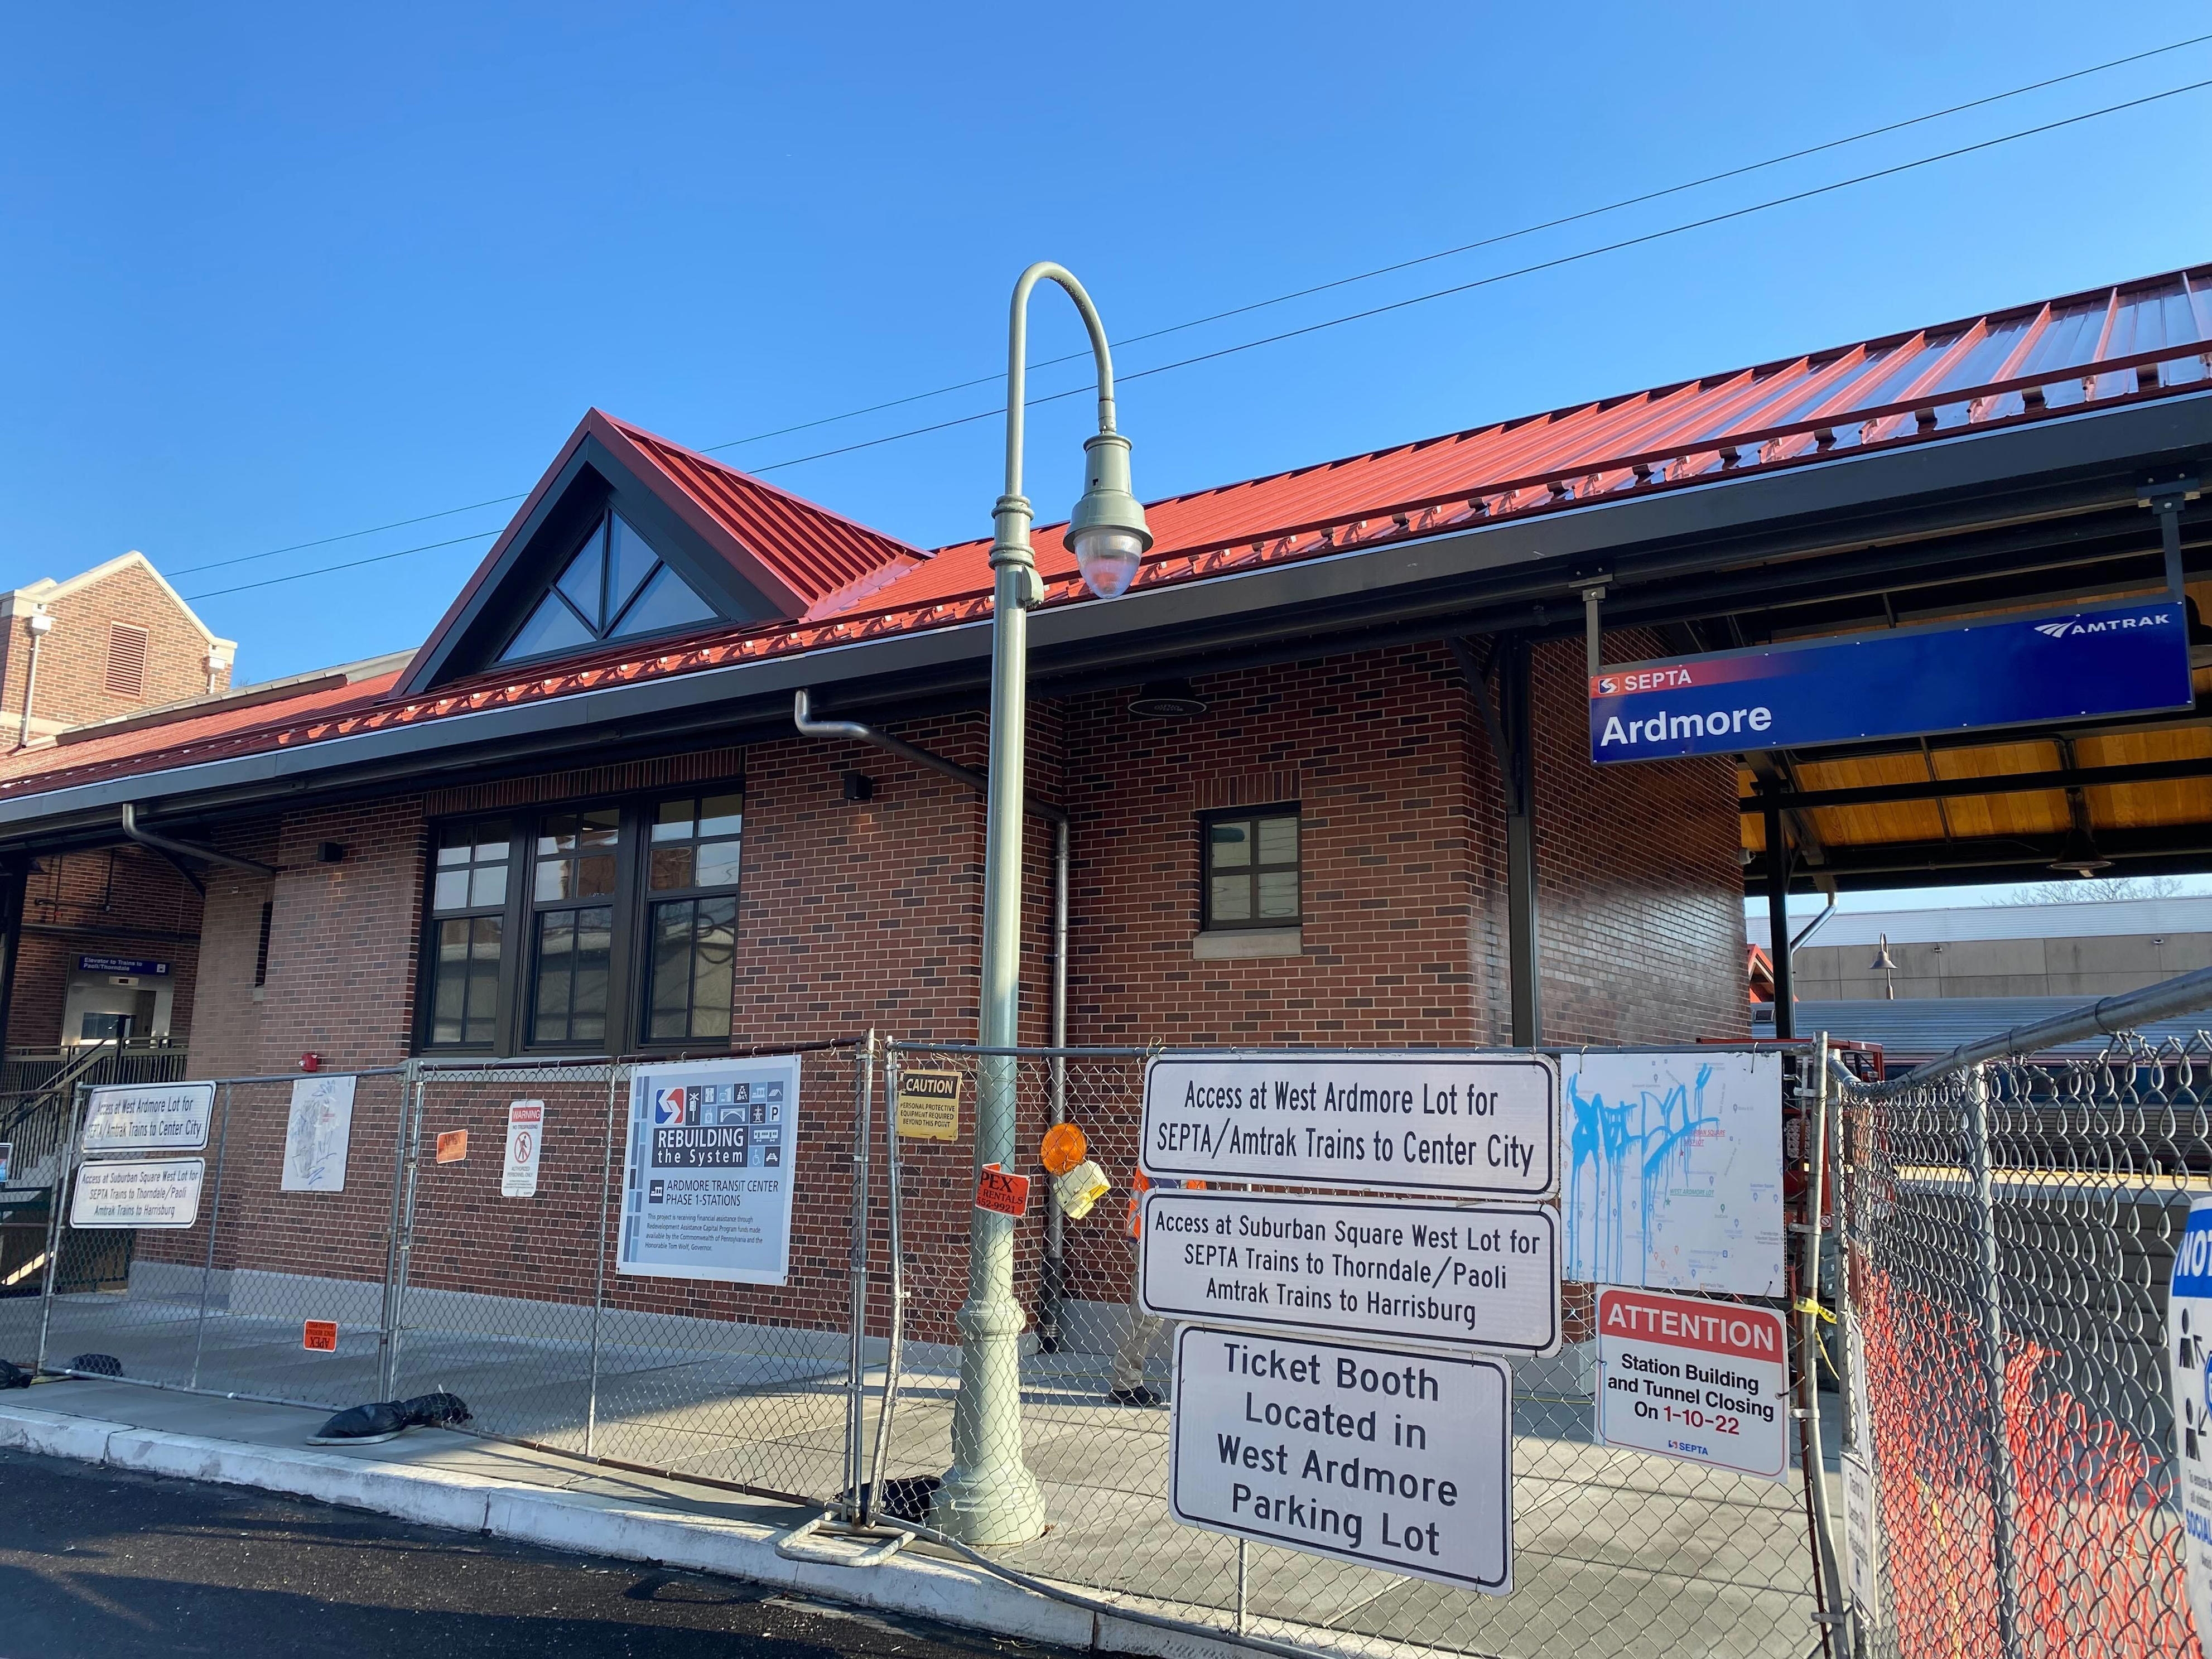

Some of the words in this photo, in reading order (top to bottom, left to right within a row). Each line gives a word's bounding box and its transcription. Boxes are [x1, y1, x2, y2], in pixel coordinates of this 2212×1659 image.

[2071, 614, 2170, 635] AMTRAK
[1625, 669, 1692, 691] SEPTA
[1601, 707, 1772, 747] Ardmore
[906, 1078, 953, 1093] CAUTION
[97, 1102, 113, 1115] Access
[114, 1100, 121, 1114] at
[122, 1099, 135, 1114] West
[137, 1097, 165, 1113] Ardmore
[168, 1096, 180, 1112] Lot
[182, 1096, 194, 1111] for
[926, 1103, 955, 1112] PROTECTIVE
[1184, 1081, 1242, 1110] Access
[1250, 1081, 1267, 1110] at
[1275, 1081, 1317, 1112] West
[1324, 1082, 1413, 1114] Ardmore
[1424, 1083, 1458, 1116] Lot
[1467, 1083, 1498, 1117] for
[513, 1110, 541, 1119] WARNING
[87, 1120, 127, 1141] SEPTA/Amtrak
[129, 1122, 147, 1137] Trains
[150, 1122, 157, 1136] to
[159, 1120, 183, 1136] Center
[186, 1119, 201, 1139] City
[658, 1128, 744, 1148] REBUILDING
[658, 1149, 681, 1164] the
[690, 1149, 743, 1166] System
[1157, 1118, 1298, 1159] SEPTA/Amtrak
[1306, 1128, 1365, 1161] Trains
[1374, 1131, 1394, 1162] to
[1404, 1130, 1477, 1166] Center
[1487, 1134, 1535, 1177] City
[82, 1174, 100, 1184] Access
[103, 1173, 109, 1183] at
[110, 1173, 138, 1183] Suburban
[139, 1171, 160, 1185] Square
[162, 1171, 176, 1182] West
[177, 1170, 187, 1181] Lot
[189, 1169, 199, 1180] for
[667, 1180, 709, 1191] ARDMORE
[712, 1180, 746, 1192] TRANSIT
[747, 1180, 779, 1192] CENTER
[980, 1170, 1014, 1193] PEX
[89, 1189, 108, 1199] SEPTA
[110, 1188, 127, 1199] Trains
[128, 1188, 134, 1199] to
[137, 1185, 187, 1200] Thorndale/Paoli
[666, 1194, 692, 1205] PHASE
[696, 1194, 741, 1206] 1-STATIONS
[984, 1189, 1023, 1204] RENTALS
[94, 1205, 115, 1216] Amtrak
[117, 1205, 134, 1216] Trains
[136, 1205, 142, 1215] to
[144, 1205, 175, 1218] Harrisburg
[738, 1216, 753, 1224] through
[721, 1235, 746, 1244] Pennsylvania
[1155, 1211, 1208, 1234] Access
[1216, 1214, 1232, 1235] at
[1238, 1215, 1327, 1242] Suburban
[1334, 1219, 1404, 1248] Square
[1412, 1224, 1458, 1250] West
[1467, 1227, 1502, 1252] Lot
[1510, 1228, 1541, 1255] for
[1184, 1244, 1238, 1269] SEPTA
[1246, 1247, 1299, 1273] Trains
[1307, 1251, 1324, 1275] to
[1332, 1255, 1507, 1289] Thorndale/Paoli
[1206, 1277, 1268, 1304] Amtrak
[1276, 1283, 1332, 1310] Trains
[1339, 1288, 1357, 1313] to
[1367, 1291, 1476, 1330] Harrisburg
[1607, 1303, 1774, 1352] ATTENTION
[310, 1337, 330, 1349] APEX
[1224, 1343, 1321, 1385] Ticket
[1337, 1357, 1438, 1401] Booth
[1622, 1353, 1680, 1378] Station
[1686, 1364, 1758, 1396] Building
[1608, 1377, 1638, 1393] and
[1643, 1380, 1700, 1404] Tunnel
[1705, 1391, 1774, 1422] Closing
[1246, 1392, 1376, 1441] Located
[1395, 1414, 1426, 1450] in
[1635, 1401, 1659, 1420] On
[1664, 1406, 1739, 1435] 1-10-22
[1679, 1442, 1708, 1455] SEPTA
[1217, 1433, 1288, 1475] West
[1302, 1450, 1458, 1507] Ardmore
[1232, 1483, 1362, 1549] Parking
[1382, 1512, 1440, 1556] Lot
[2186, 1508, 2212, 1546] SOCIAL
